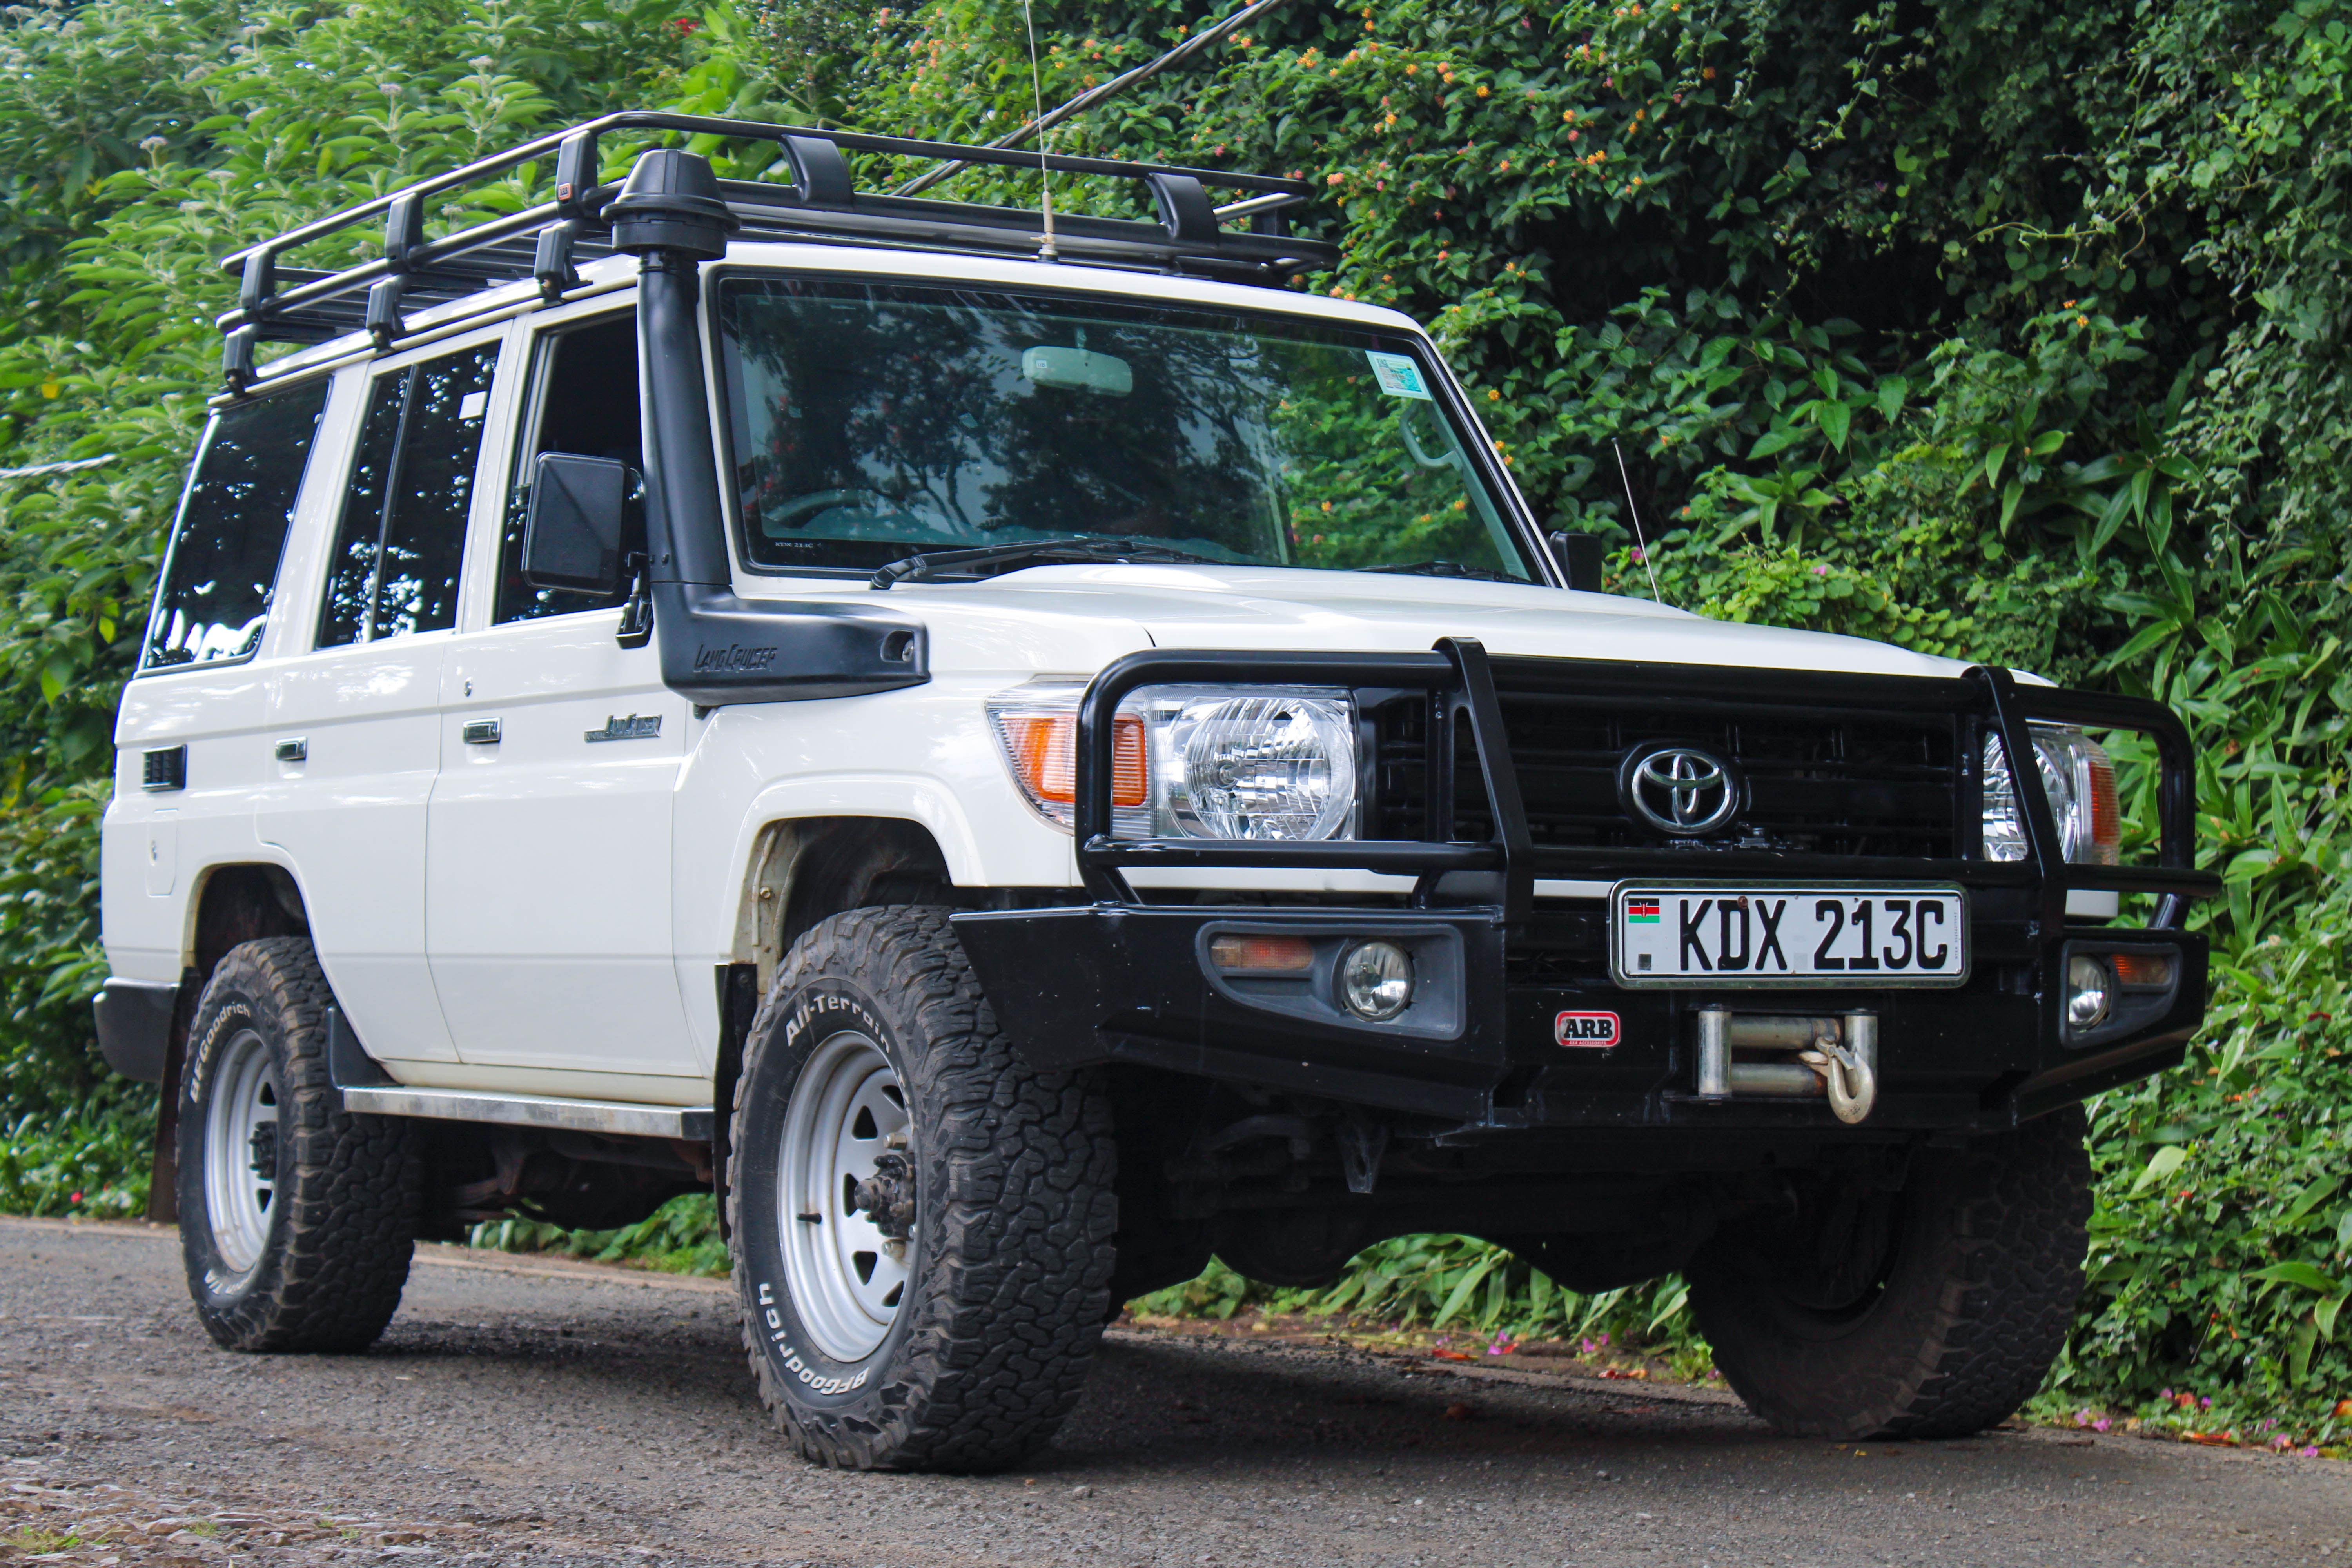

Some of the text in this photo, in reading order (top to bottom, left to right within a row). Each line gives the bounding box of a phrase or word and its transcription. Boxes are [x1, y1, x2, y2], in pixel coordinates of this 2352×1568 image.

[1679, 899, 1788, 971] KDX
[1813, 900, 1948, 970] 213C
[190, 1001, 251, 1103] BFGoodrich
[786, 994, 889, 1054] All-Terrain
[1563, 1019, 1613, 1038] ARB
[759, 1283, 869, 1395] BFGoodrich
